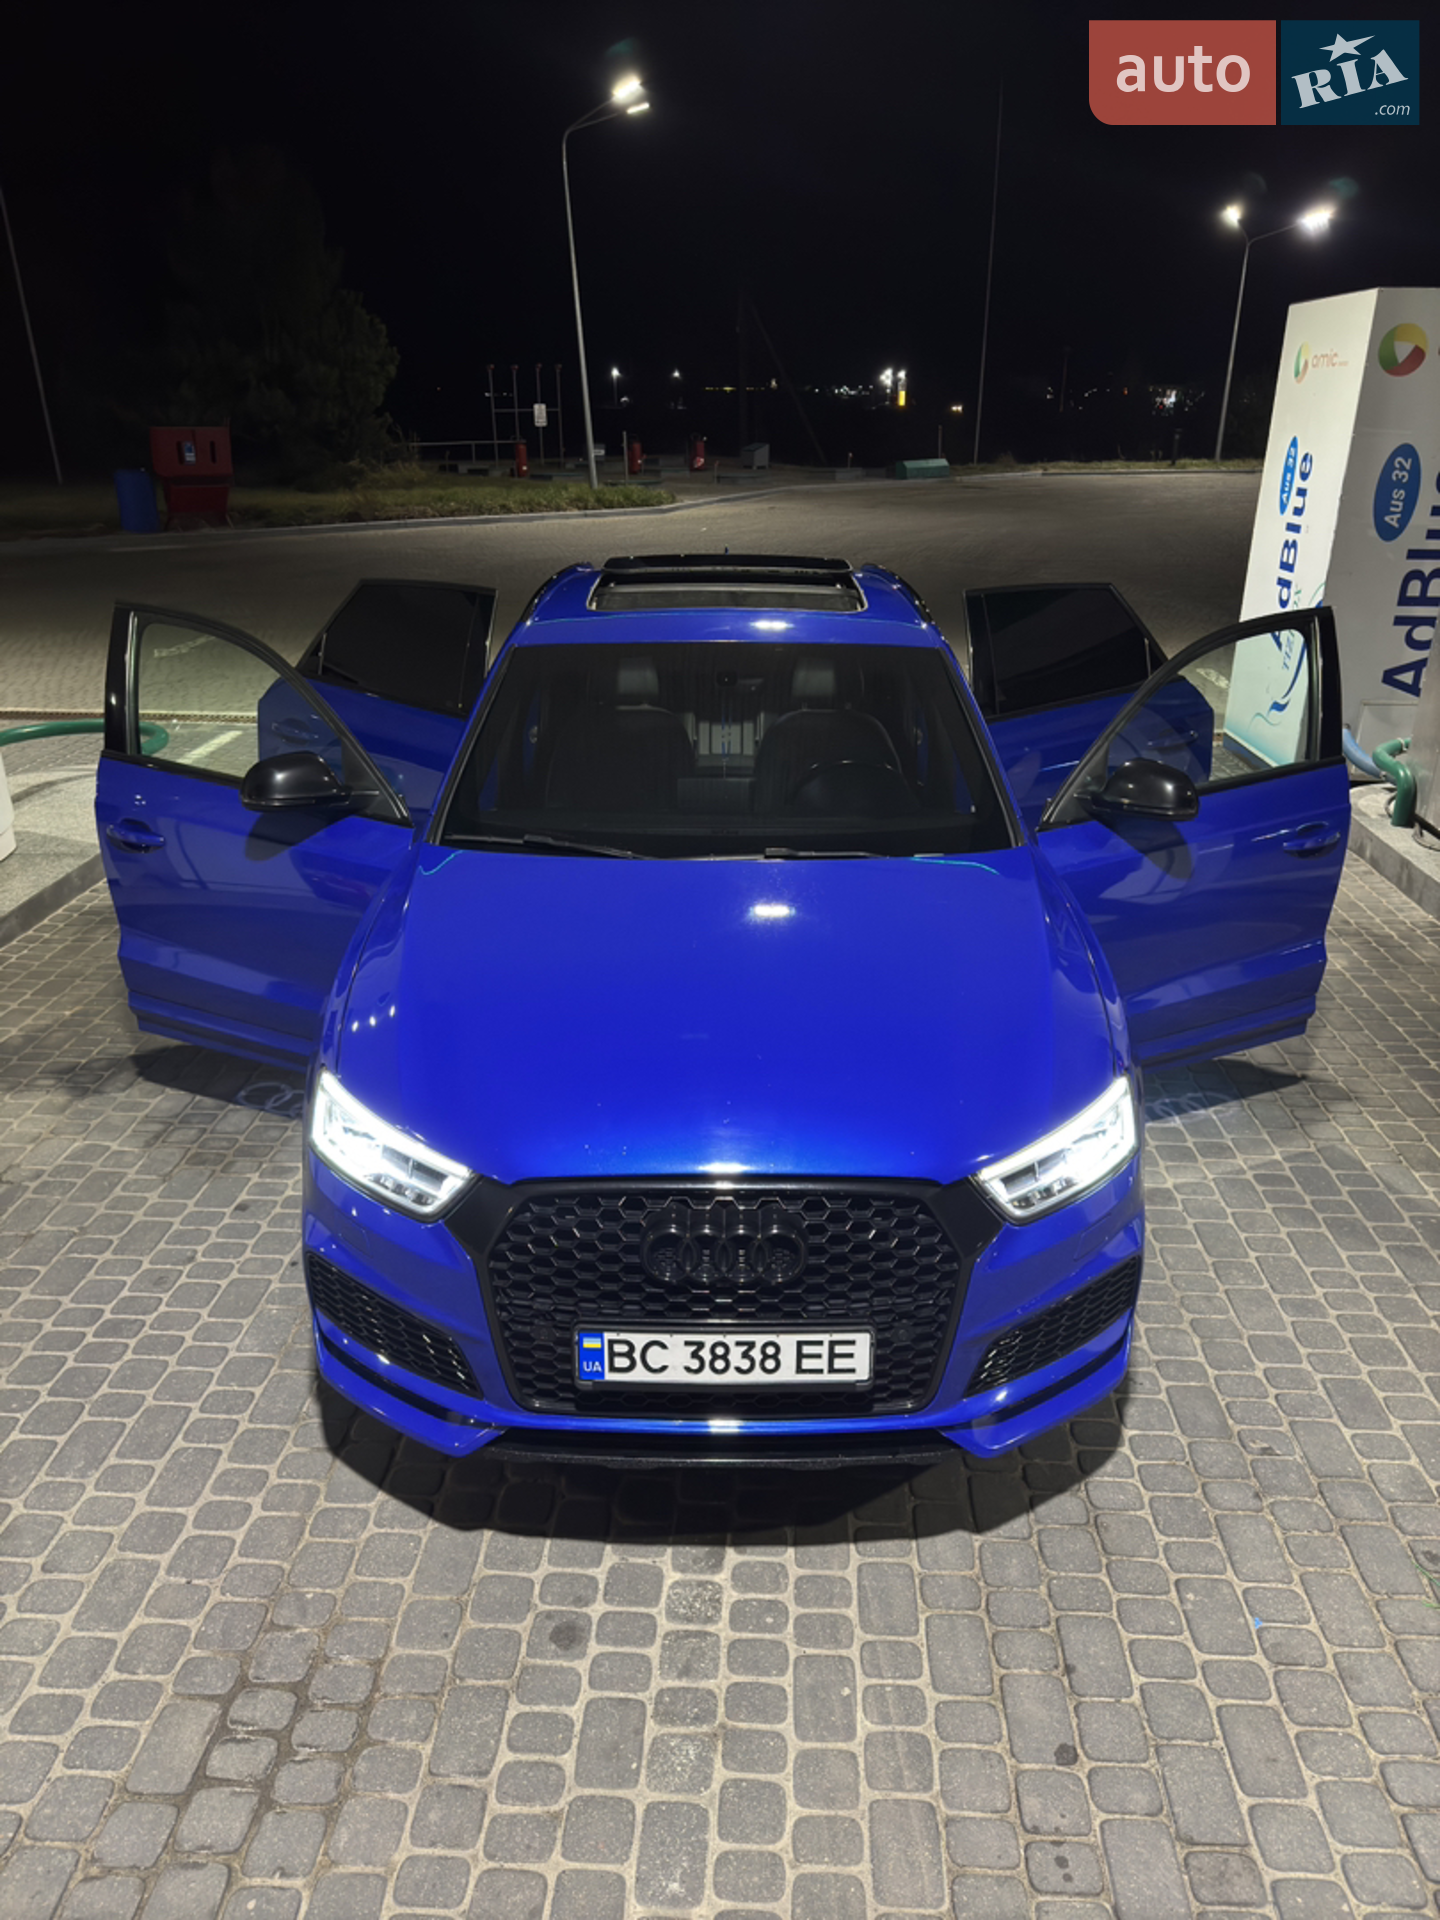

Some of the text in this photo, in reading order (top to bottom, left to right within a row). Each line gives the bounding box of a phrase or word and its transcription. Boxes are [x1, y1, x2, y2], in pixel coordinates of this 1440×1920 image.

[1282, 472, 1292, 505] Aus
[1384, 456, 1412, 529] Aus 32
[1381, 472, 1440, 698] AdBl
[583, 1360, 602, 1372] UA
[607, 1339, 856, 1375] BC 3838 EE
